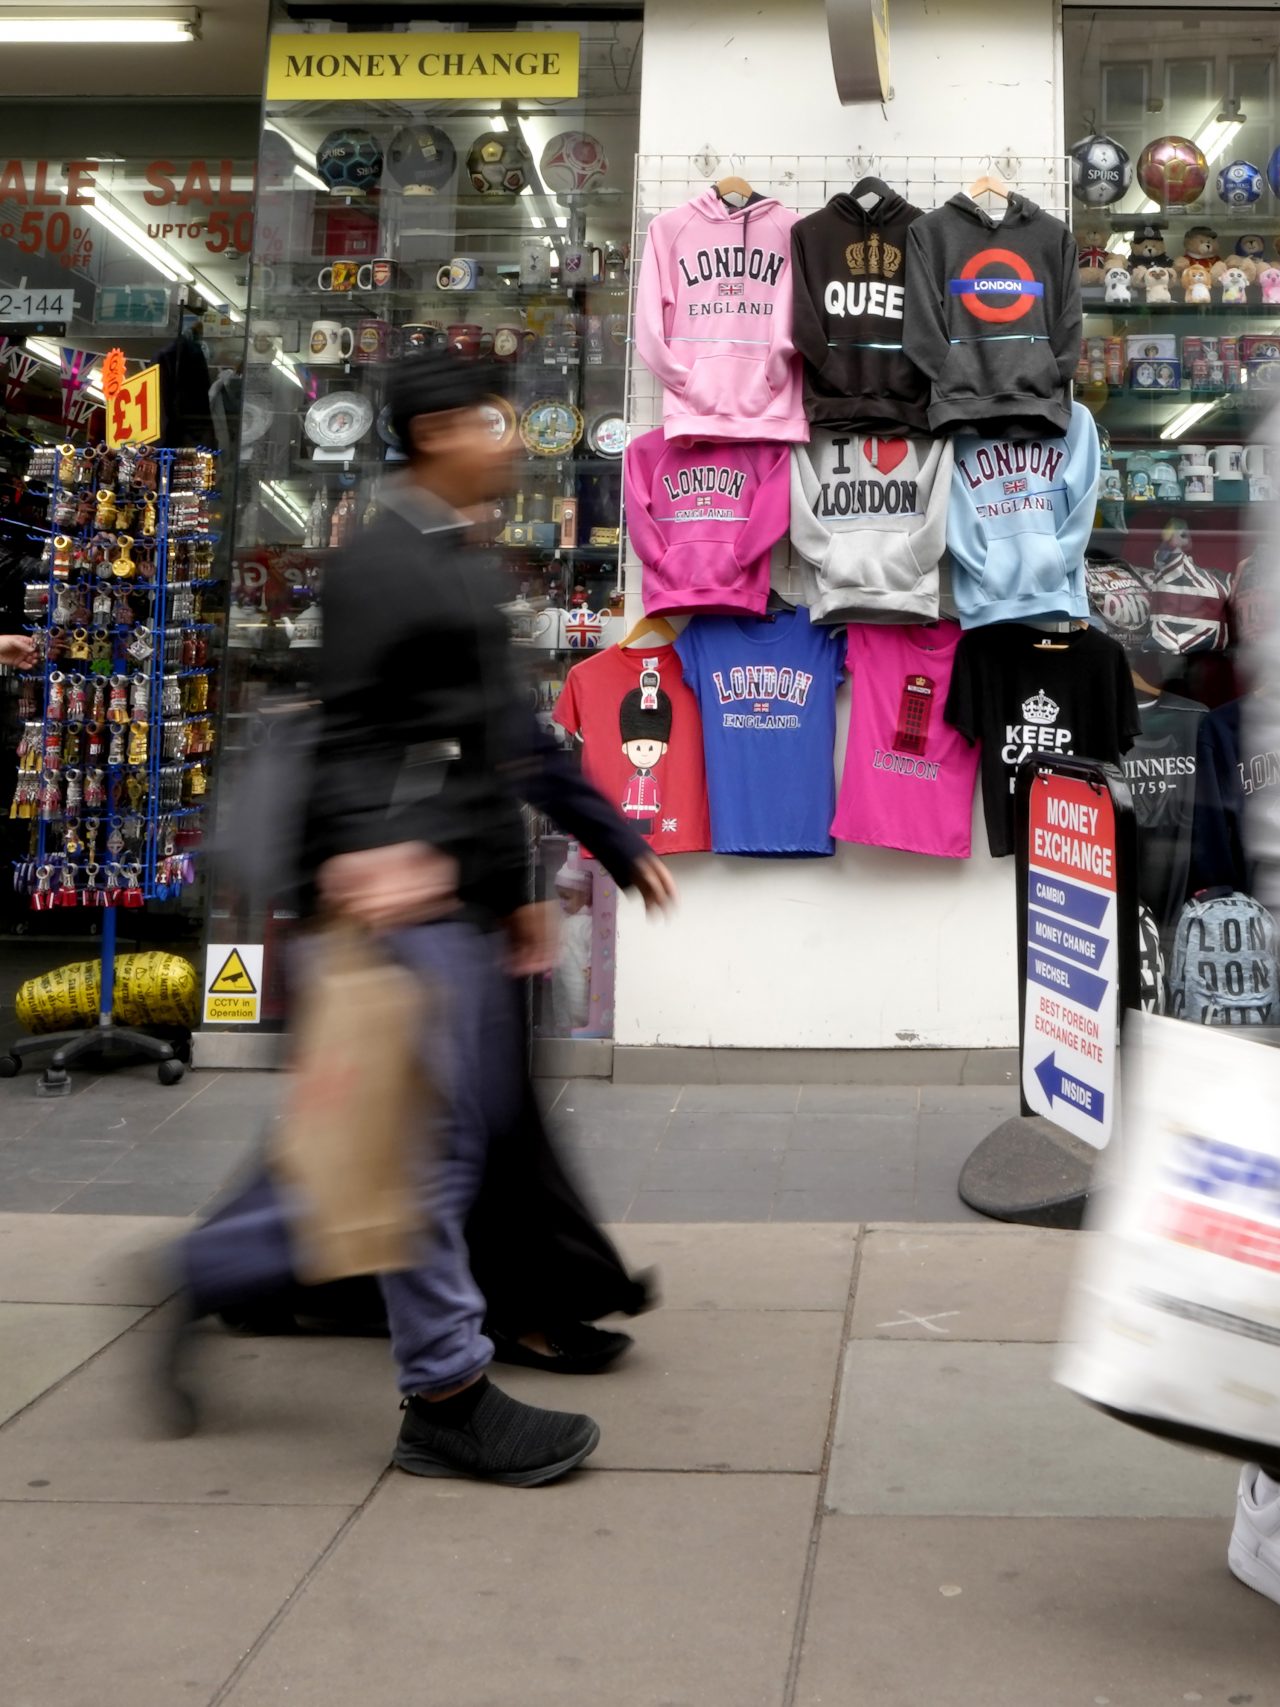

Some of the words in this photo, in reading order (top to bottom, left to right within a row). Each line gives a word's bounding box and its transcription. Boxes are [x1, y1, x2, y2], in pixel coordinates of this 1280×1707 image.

[285, 54, 409, 77] MONEY
[418, 53, 561, 76] CHANGE
[1087, 169, 1120, 181] SPURS
[18, 211, 93, 253] 50%
[60, 254, 92, 268] OFF
[678, 246, 785, 288] LONDON
[974, 280, 1022, 292] LONDON
[688, 301, 774, 317] ENGLAND
[113, 381, 148, 443] £1
[832, 438, 851, 475] I
[959, 441, 1064, 490] LONDON
[662, 465, 747, 502] LONDON
[821, 480, 919, 516] LONDON
[975, 497, 1054, 518] ENGLAND
[713, 666, 813, 706] LONDON
[1006, 725, 1072, 747] KEEP
[873, 750, 941, 781] LONDON
[1001, 744, 1075, 764] CA
[1047, 797, 1099, 836] MONEY
[1034, 828, 1112, 878] EXCHANGE
[1036, 882, 1066, 905] CAMBIO
[1035, 921, 1062, 944] MONEY
[1063, 932, 1096, 959] CHANGE
[1034, 958, 1071, 988] WECHSEL
[210, 1008, 253, 1018] Operation
[214, 998, 240, 1007] CCTV
[242, 999, 250, 1007] in
[1040, 996, 1060, 1017] BEST
[1062, 1007, 1099, 1040] FOREIGN
[1035, 1014, 1079, 1051] EXCHANGE
[1081, 1038, 1103, 1064] RATE
[1061, 1076, 1092, 1110] INSIDE
